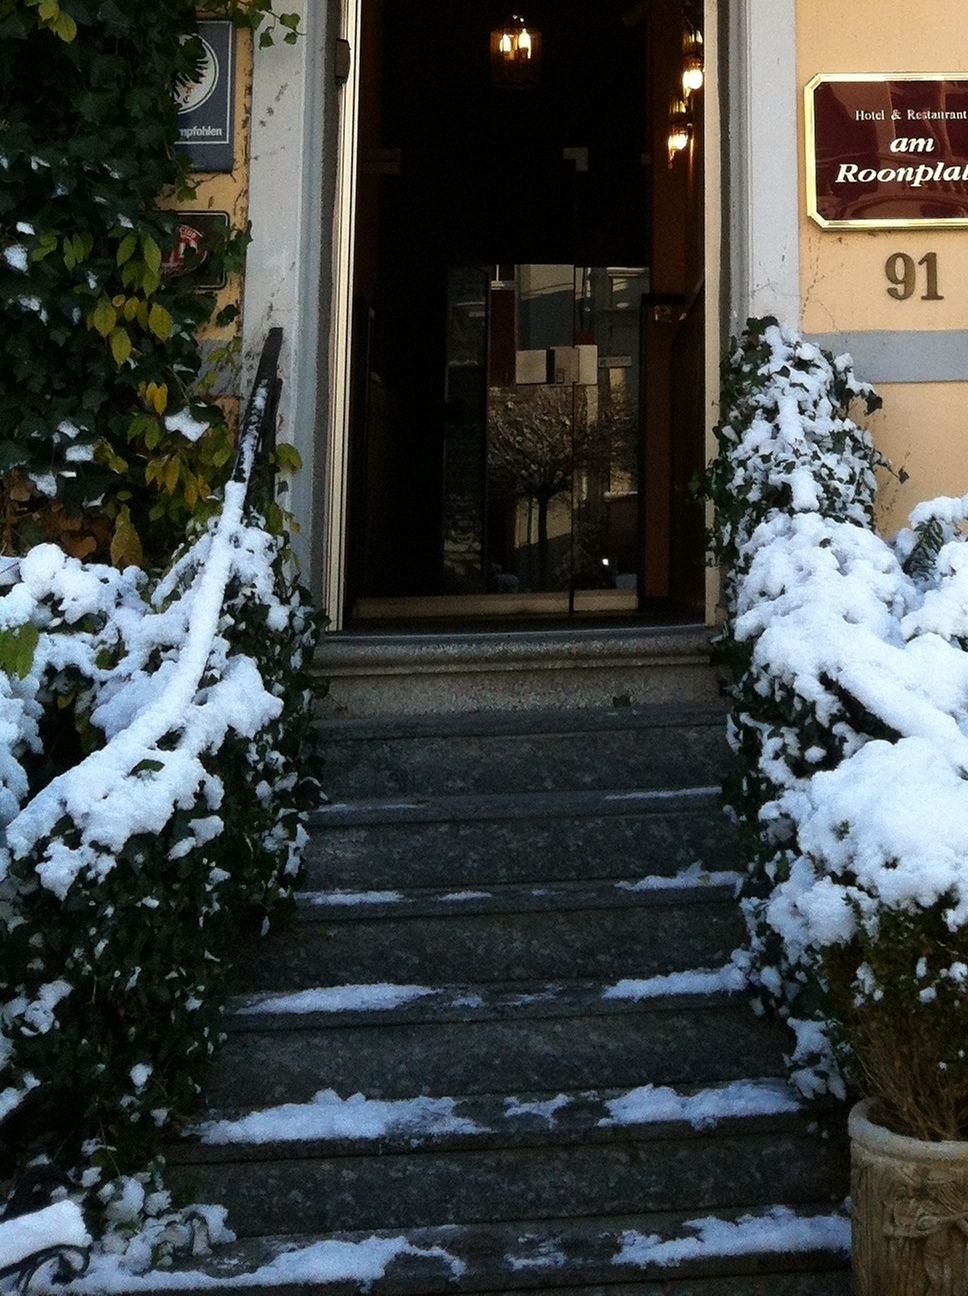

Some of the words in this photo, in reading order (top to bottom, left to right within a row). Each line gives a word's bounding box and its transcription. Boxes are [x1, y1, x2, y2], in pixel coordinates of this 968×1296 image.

[855, 110, 885, 121] Hotel
[891, 110, 902, 120] &
[907, 110, 967, 121] Restaurant
[890, 137, 935, 153] am
[885, 252, 944, 301] 91
